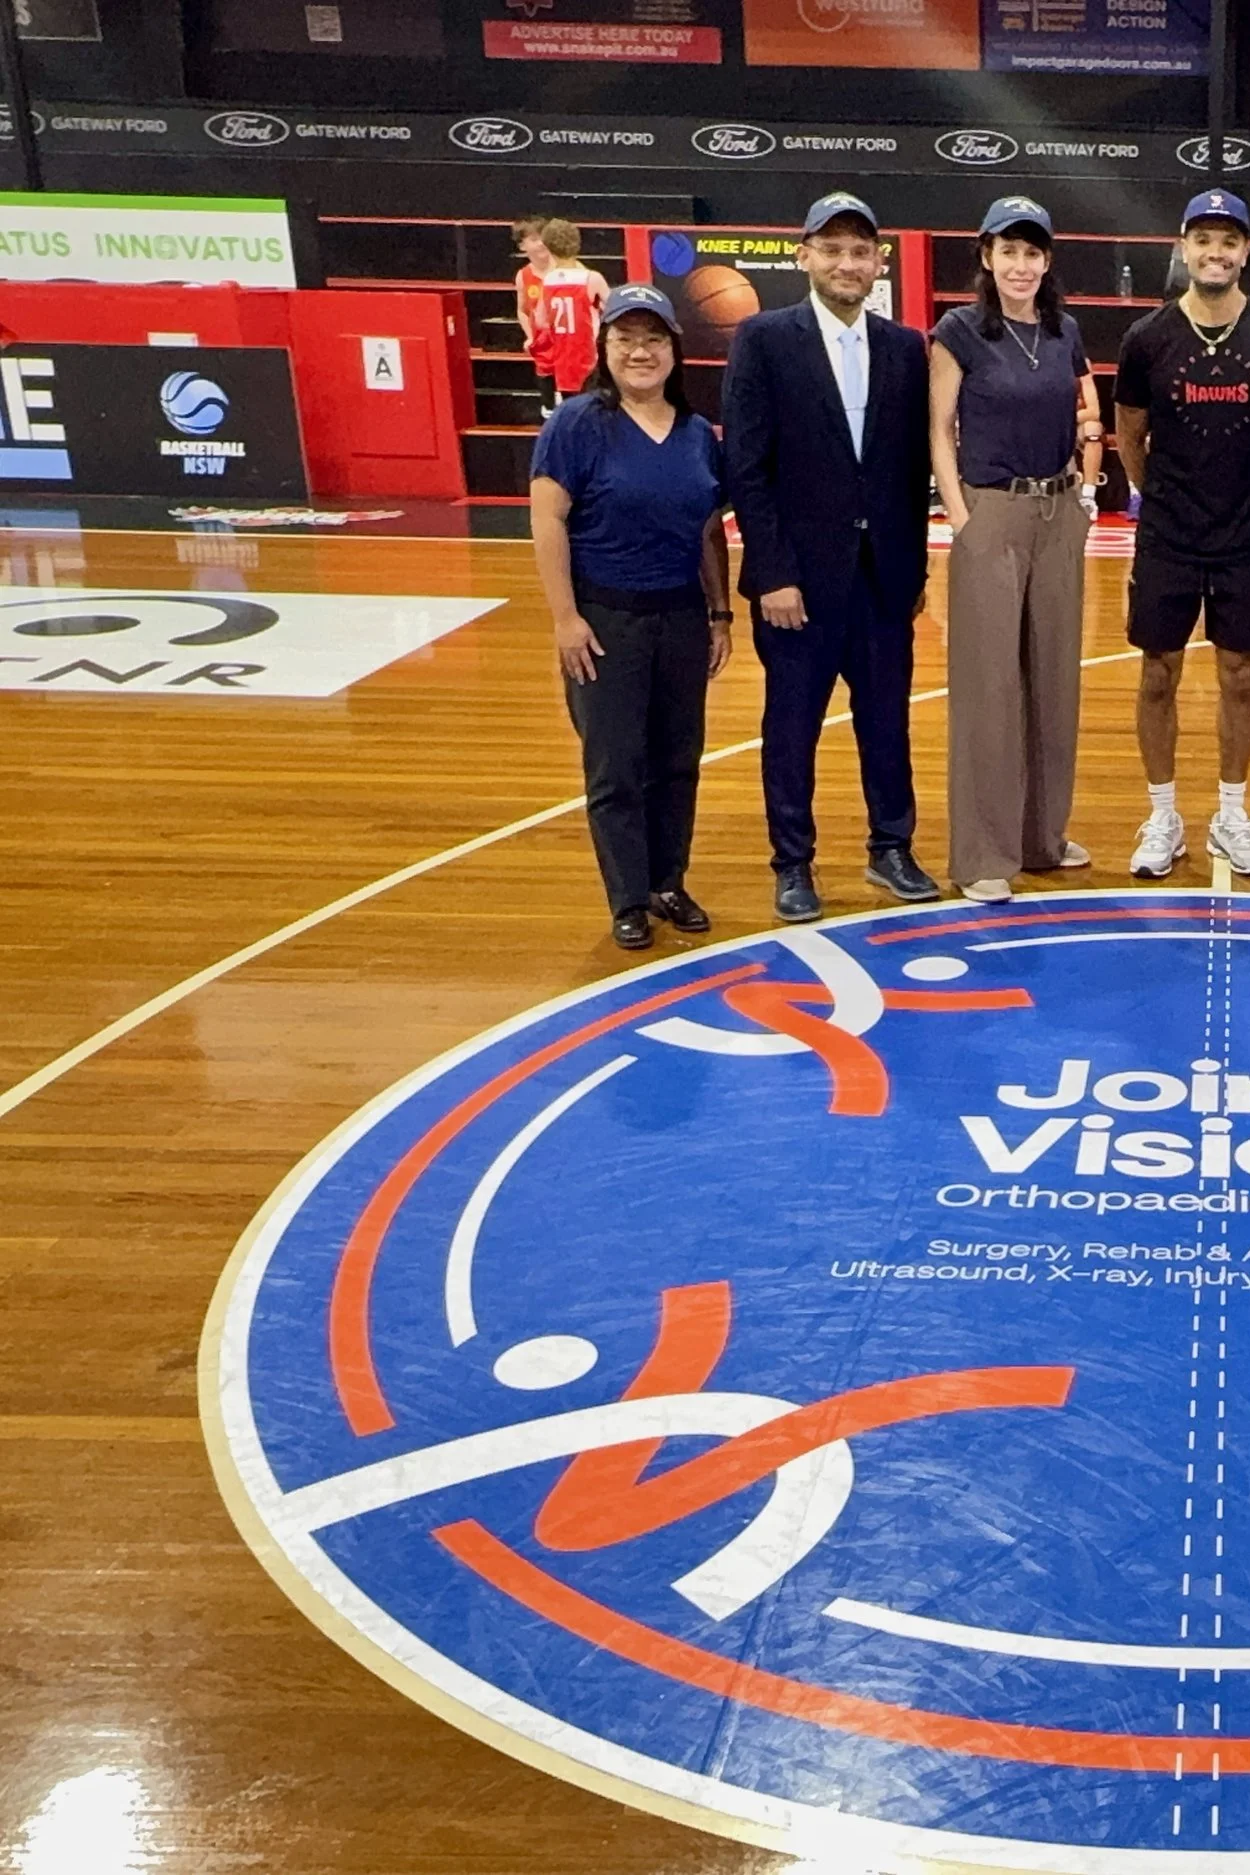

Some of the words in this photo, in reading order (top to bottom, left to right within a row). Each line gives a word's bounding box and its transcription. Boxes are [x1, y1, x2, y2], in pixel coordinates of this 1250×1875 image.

[1106, 15, 1167, 29] ACTION
[510, 25, 594, 41] ADVERTISE
[598, 28, 639, 42] HERE
[644, 29, 694, 44] TODAY
[51, 116, 123, 131] GATEWAY
[126, 119, 168, 133] FORD
[222, 116, 273, 141] Ford
[296, 124, 366, 139] GATEWAY
[370, 126, 412, 140] FORD
[466, 122, 516, 147] Ford
[540, 130, 610, 145] GATEWAY
[613, 131, 654, 146] FORD
[708, 128, 760, 153] Ford
[783, 135, 854, 150] GATEWAY
[857, 137, 897, 152] FORD
[951, 134, 1001, 159] Ford
[1025, 141, 1096, 157] GATEWAY
[1098, 143, 1139, 158] FORD
[96, 233, 284, 262] INNOVATUS
[697, 239, 740, 254] KNEE
[743, 240, 781, 255] PAIN
[551, 296, 576, 334] 21
[375, 356, 393, 377] A
[1185, 381, 1249, 404] HAWKS
[160, 440, 246, 457] BASKETBALL
[183, 456, 227, 476] NSW
[927, 1238, 1072, 1264] Surgery,
[1083, 1241, 1198, 1262] Rehab
[1206, 1244, 1232, 1262] &
[830, 1261, 1037, 1286] Ultrasound,
[1047, 1264, 1154, 1289] X-ray,
